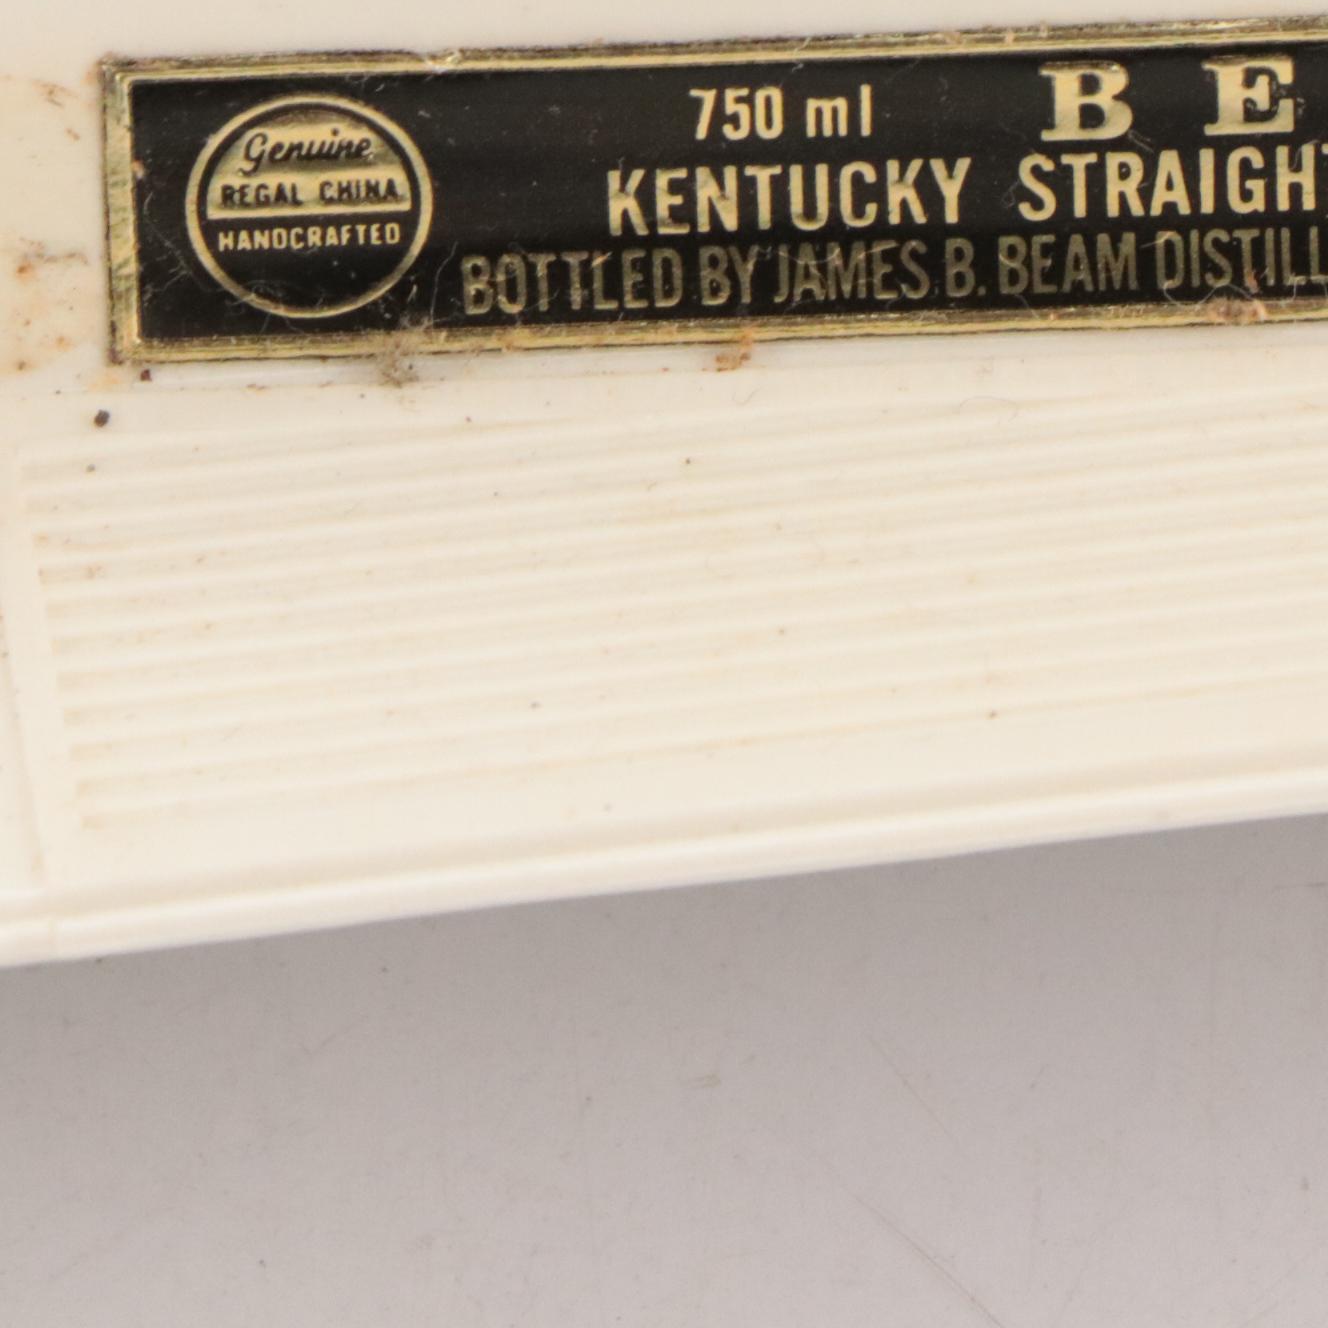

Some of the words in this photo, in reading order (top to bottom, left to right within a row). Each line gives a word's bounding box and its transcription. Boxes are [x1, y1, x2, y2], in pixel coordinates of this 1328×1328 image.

[688, 86, 786, 141] 750
[805, 83, 874, 138] ml
[238, 127, 375, 176] Genuine
[220, 182, 304, 207] REGAL
[318, 177, 401, 203] CHINA
[605, 156, 973, 238] KENTUCKY
[218, 222, 402, 253] HANDCRAFTED
[461, 250, 685, 317] BOTTLED
[699, 244, 758, 308] BY
[775, 238, 928, 304] JAMES
[945, 237, 986, 298] B.
[999, 231, 1138, 297] BEAM
